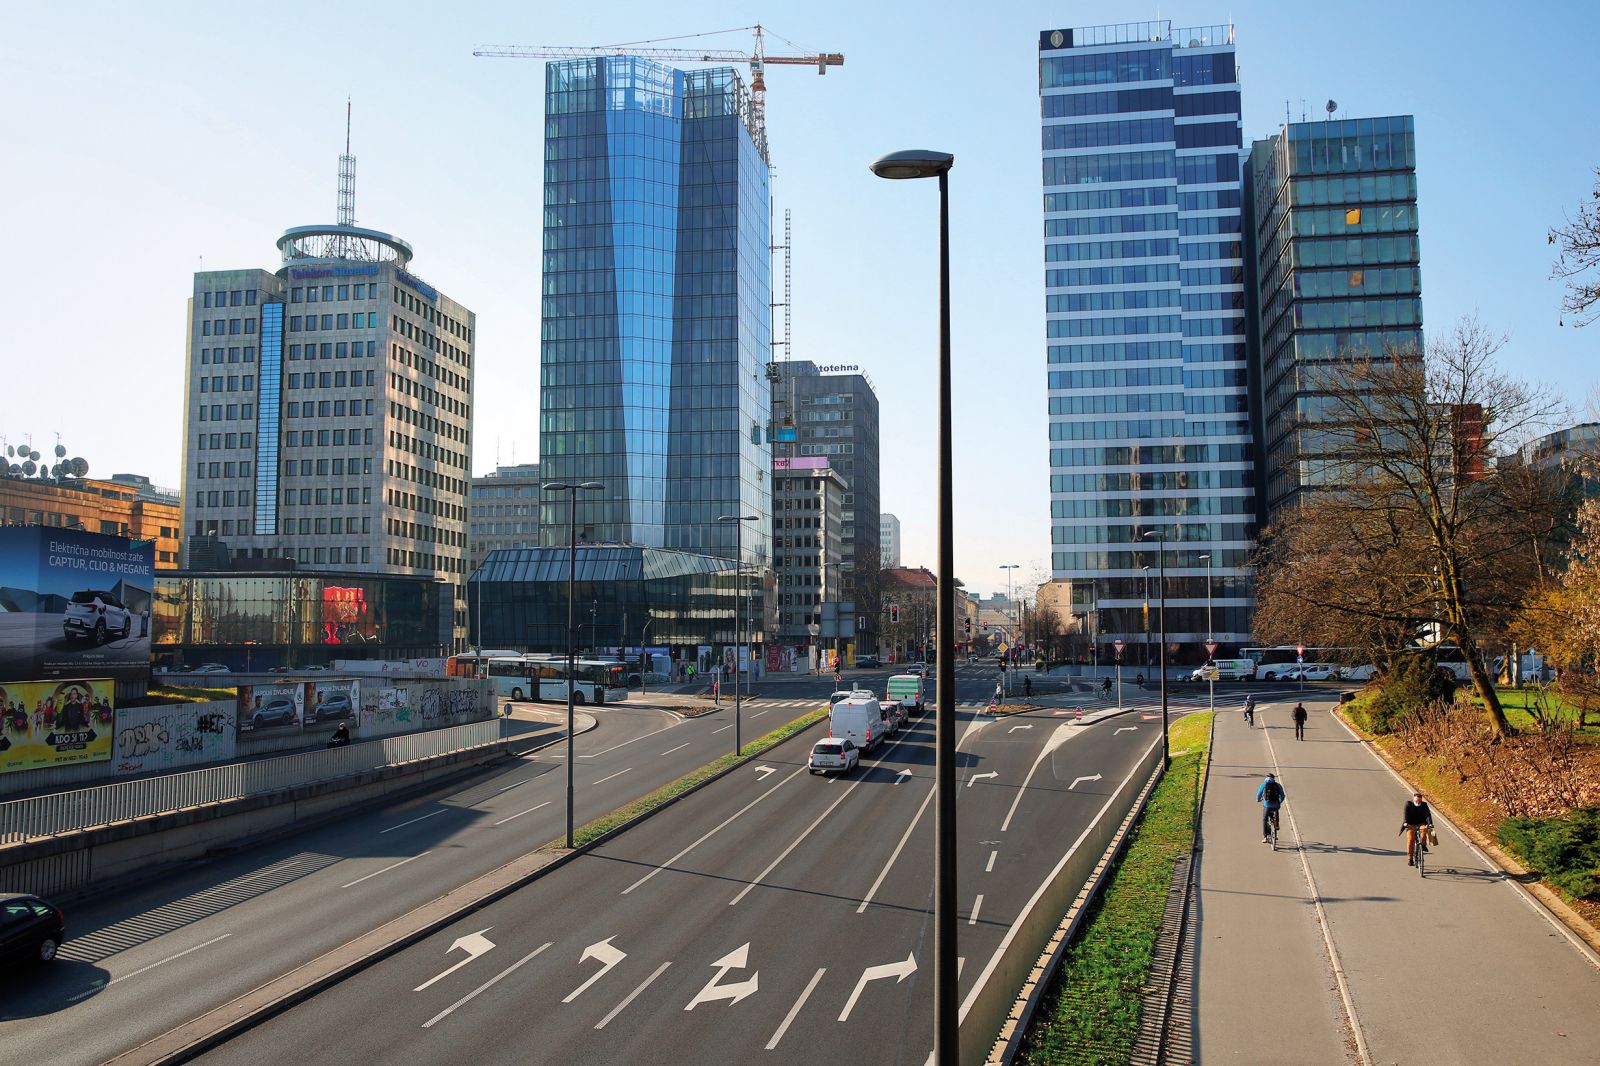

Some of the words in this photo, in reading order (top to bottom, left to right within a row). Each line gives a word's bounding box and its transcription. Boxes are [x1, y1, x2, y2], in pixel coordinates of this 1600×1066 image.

[49, 541, 89, 556] Električna
[91, 548, 128, 561] mobilnost
[128, 552, 144, 562] zate
[49, 555, 88, 571] CAPTUR,
[89, 560, 108, 572] CLIO
[109, 562, 116, 572] &
[116, 563, 150, 575] MEGANE
